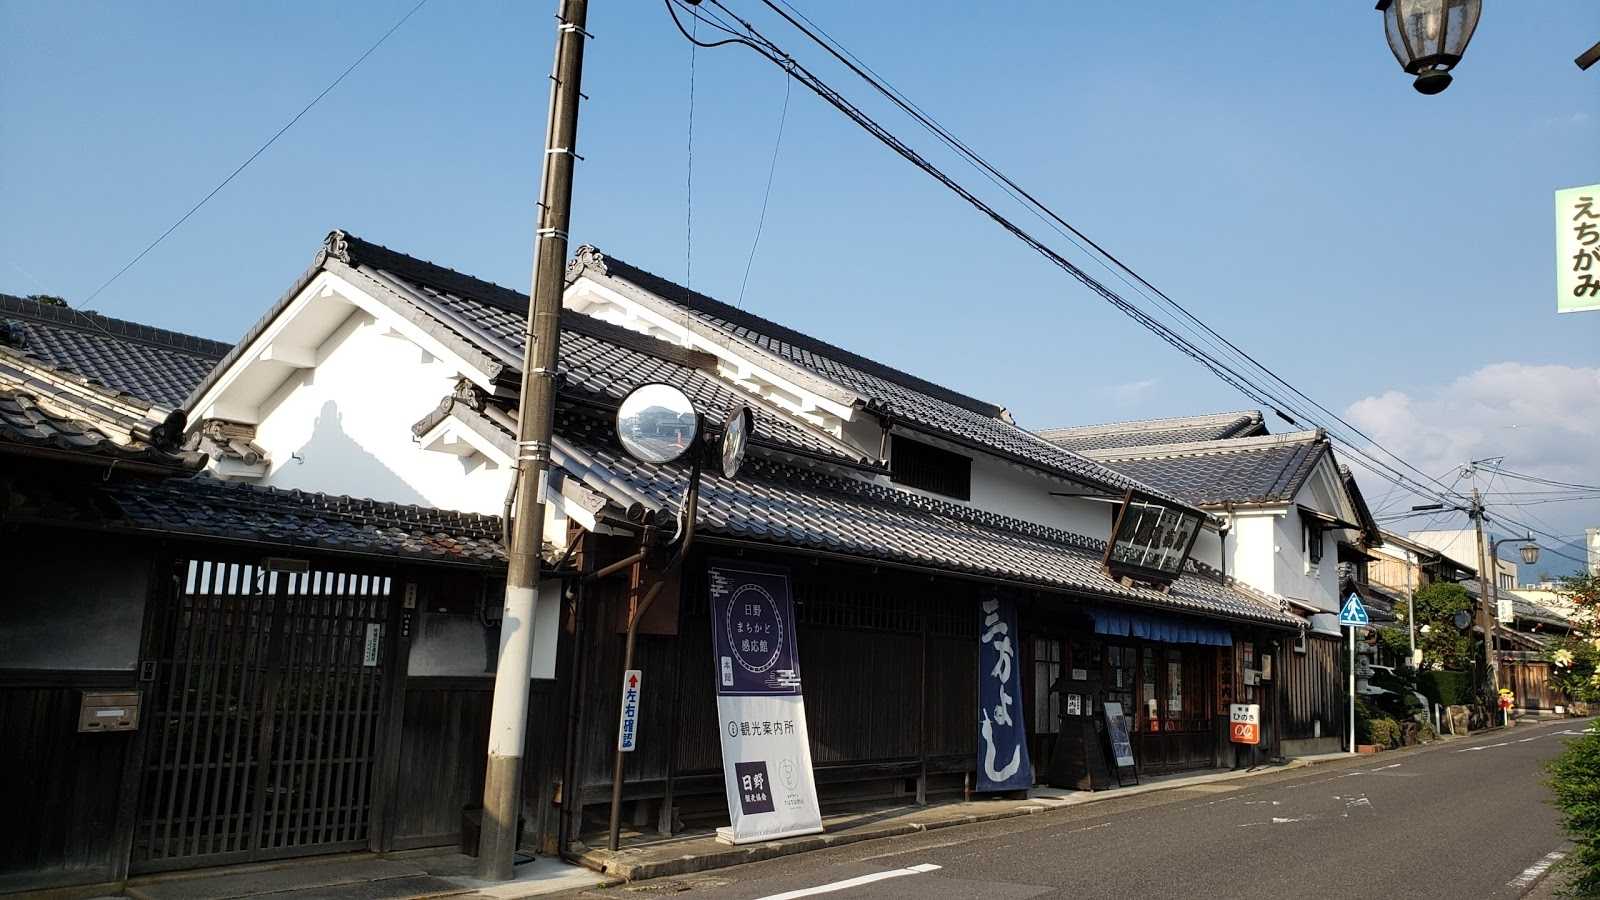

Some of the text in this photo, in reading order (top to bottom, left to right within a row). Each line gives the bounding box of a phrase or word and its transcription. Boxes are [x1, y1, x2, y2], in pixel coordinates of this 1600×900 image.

[1573, 196, 1600, 297] えちがみ
[745, 604, 761, 616] 日野
[737, 621, 771, 633] まちかど
[742, 639, 768, 652] 感応館
[623, 688, 637, 748] 左右確認
[740, 721, 794, 736] 観光案内所
[742, 773, 764, 791] 日野
